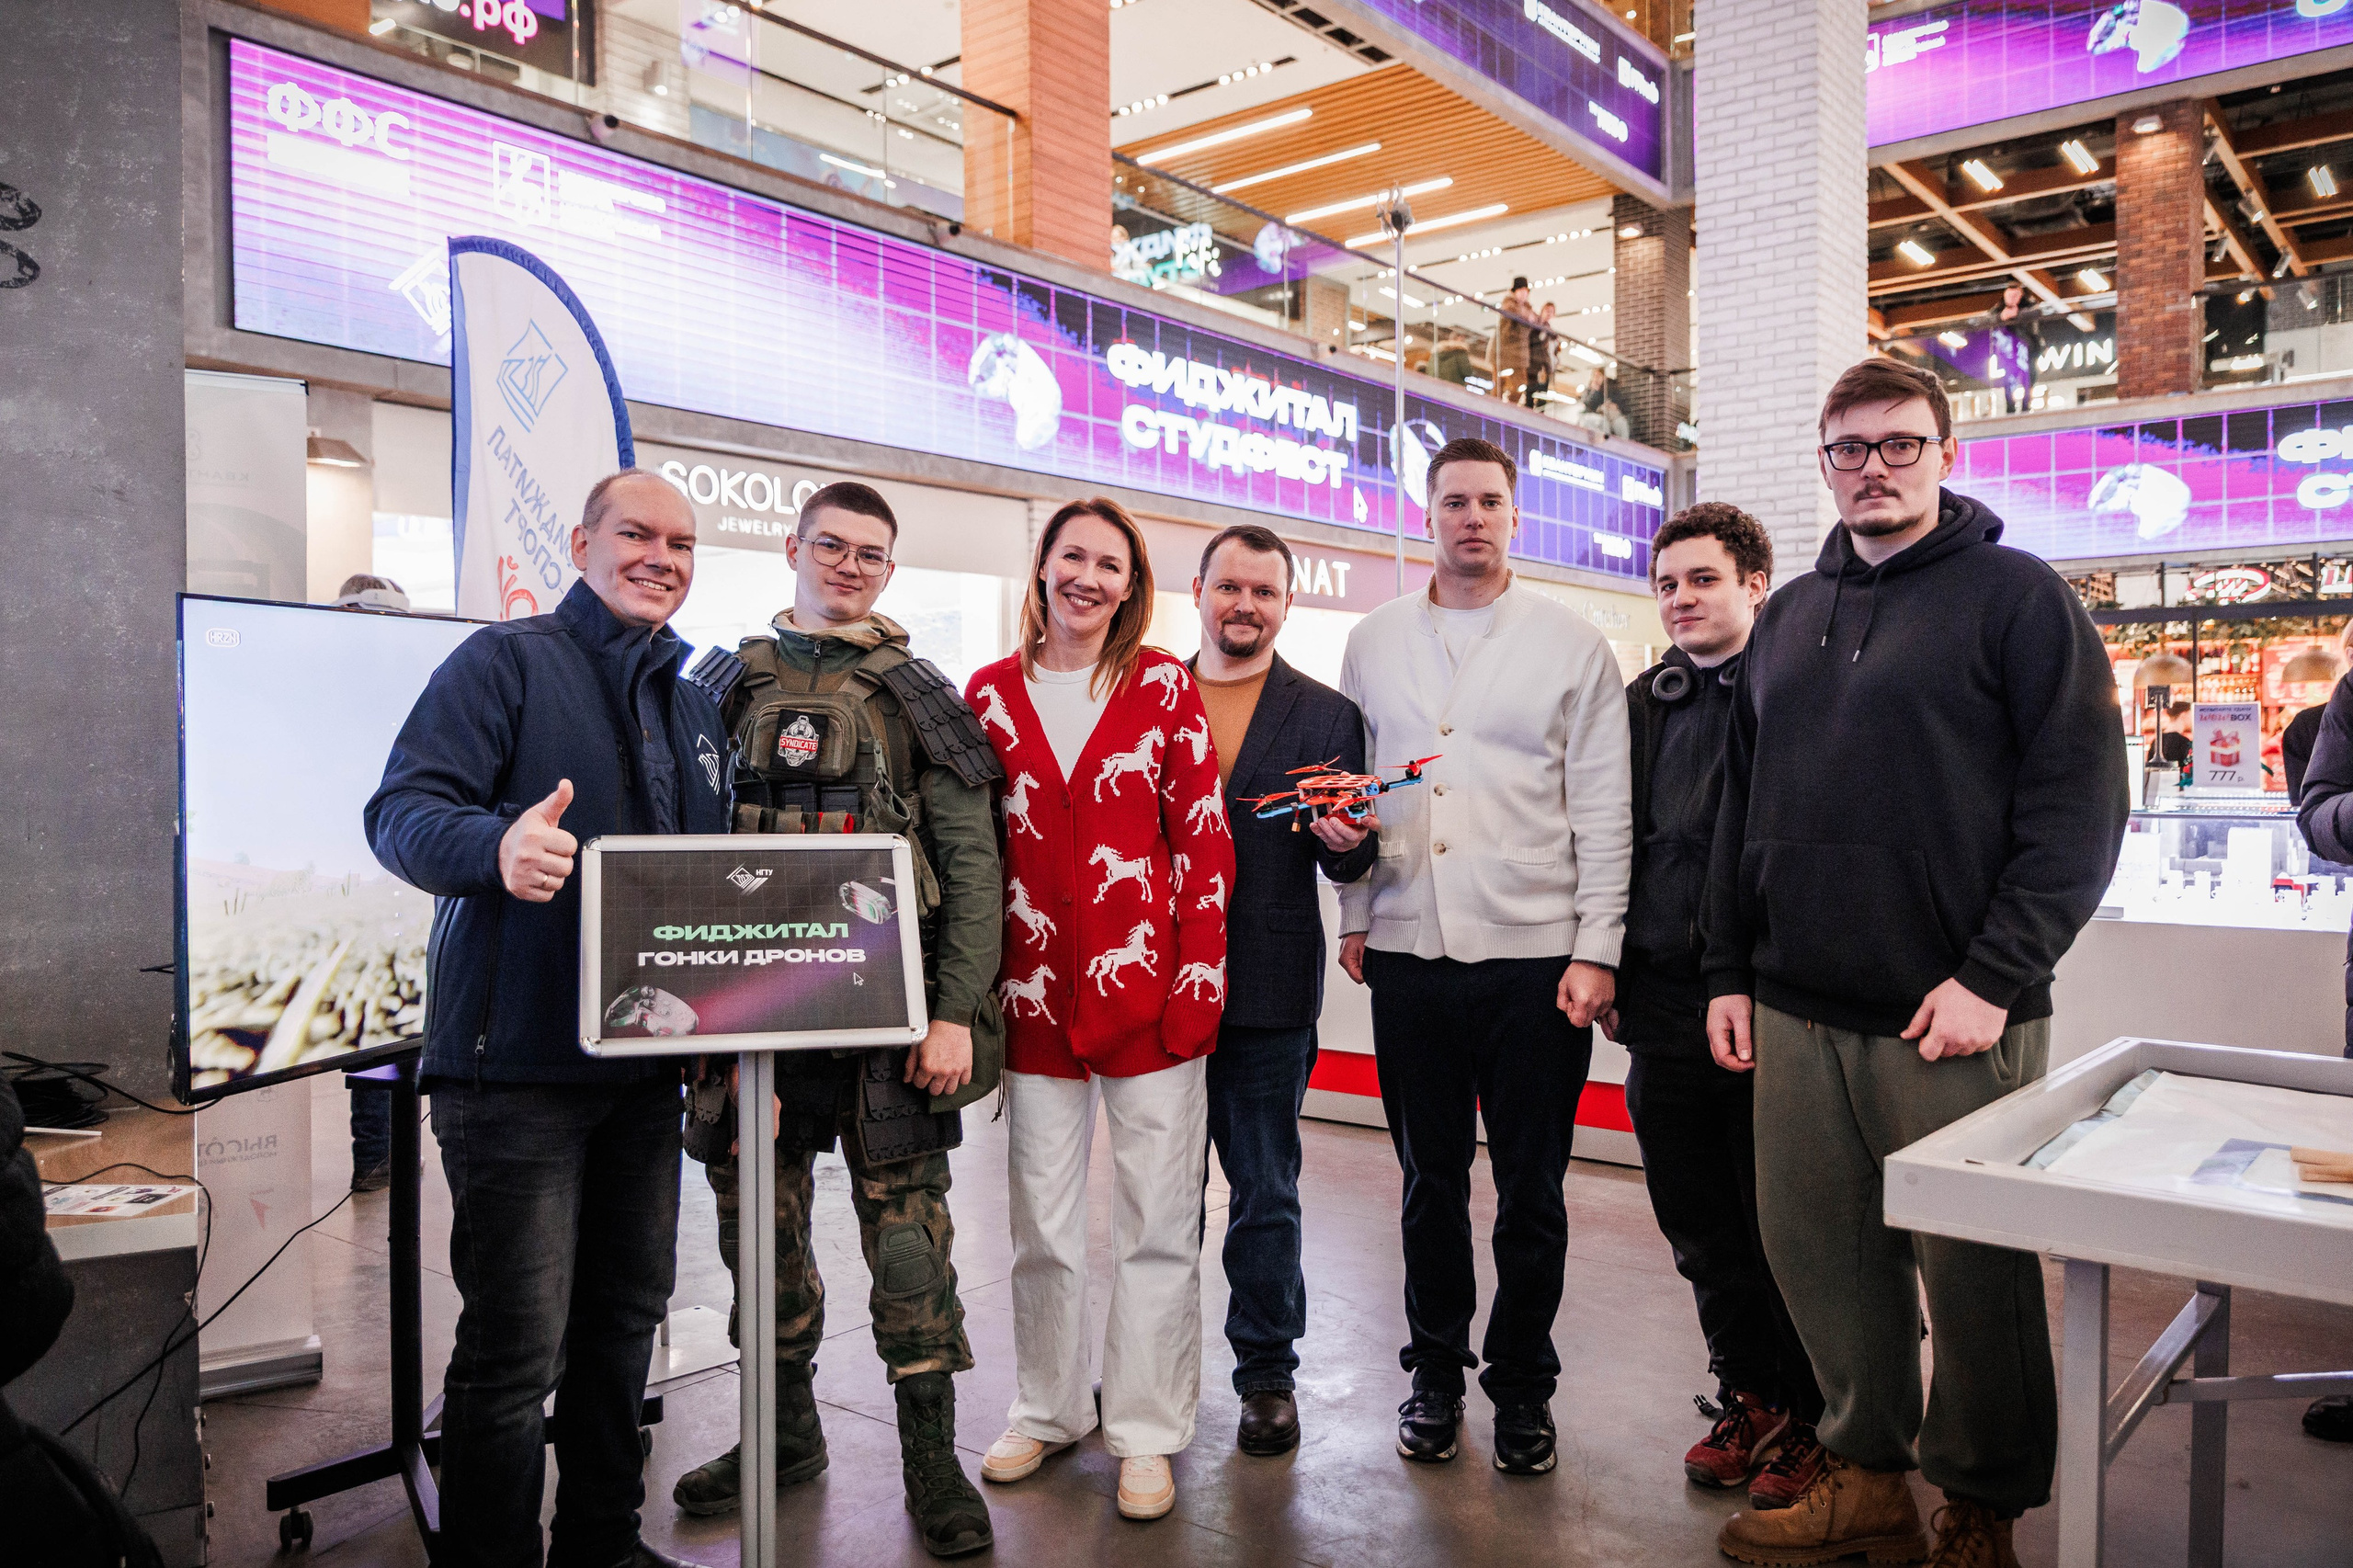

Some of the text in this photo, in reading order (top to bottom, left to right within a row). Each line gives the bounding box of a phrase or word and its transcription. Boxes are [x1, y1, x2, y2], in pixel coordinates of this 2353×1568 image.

[267, 81, 411, 161] ФФС
[1106, 343, 1358, 442] ФИДЖИТАЛ
[1121, 403, 1348, 489] СТУДФЕСТ
[661, 460, 825, 516] SOKOLO
[717, 516, 793, 538] JEWELRY
[780, 737, 818, 751] SYNDICATE
[2209, 769, 2236, 781] 777
[653, 922, 849, 942] ФИДЖИТАЛ
[638, 948, 867, 966] ГОНКИ ДРОНОВ
